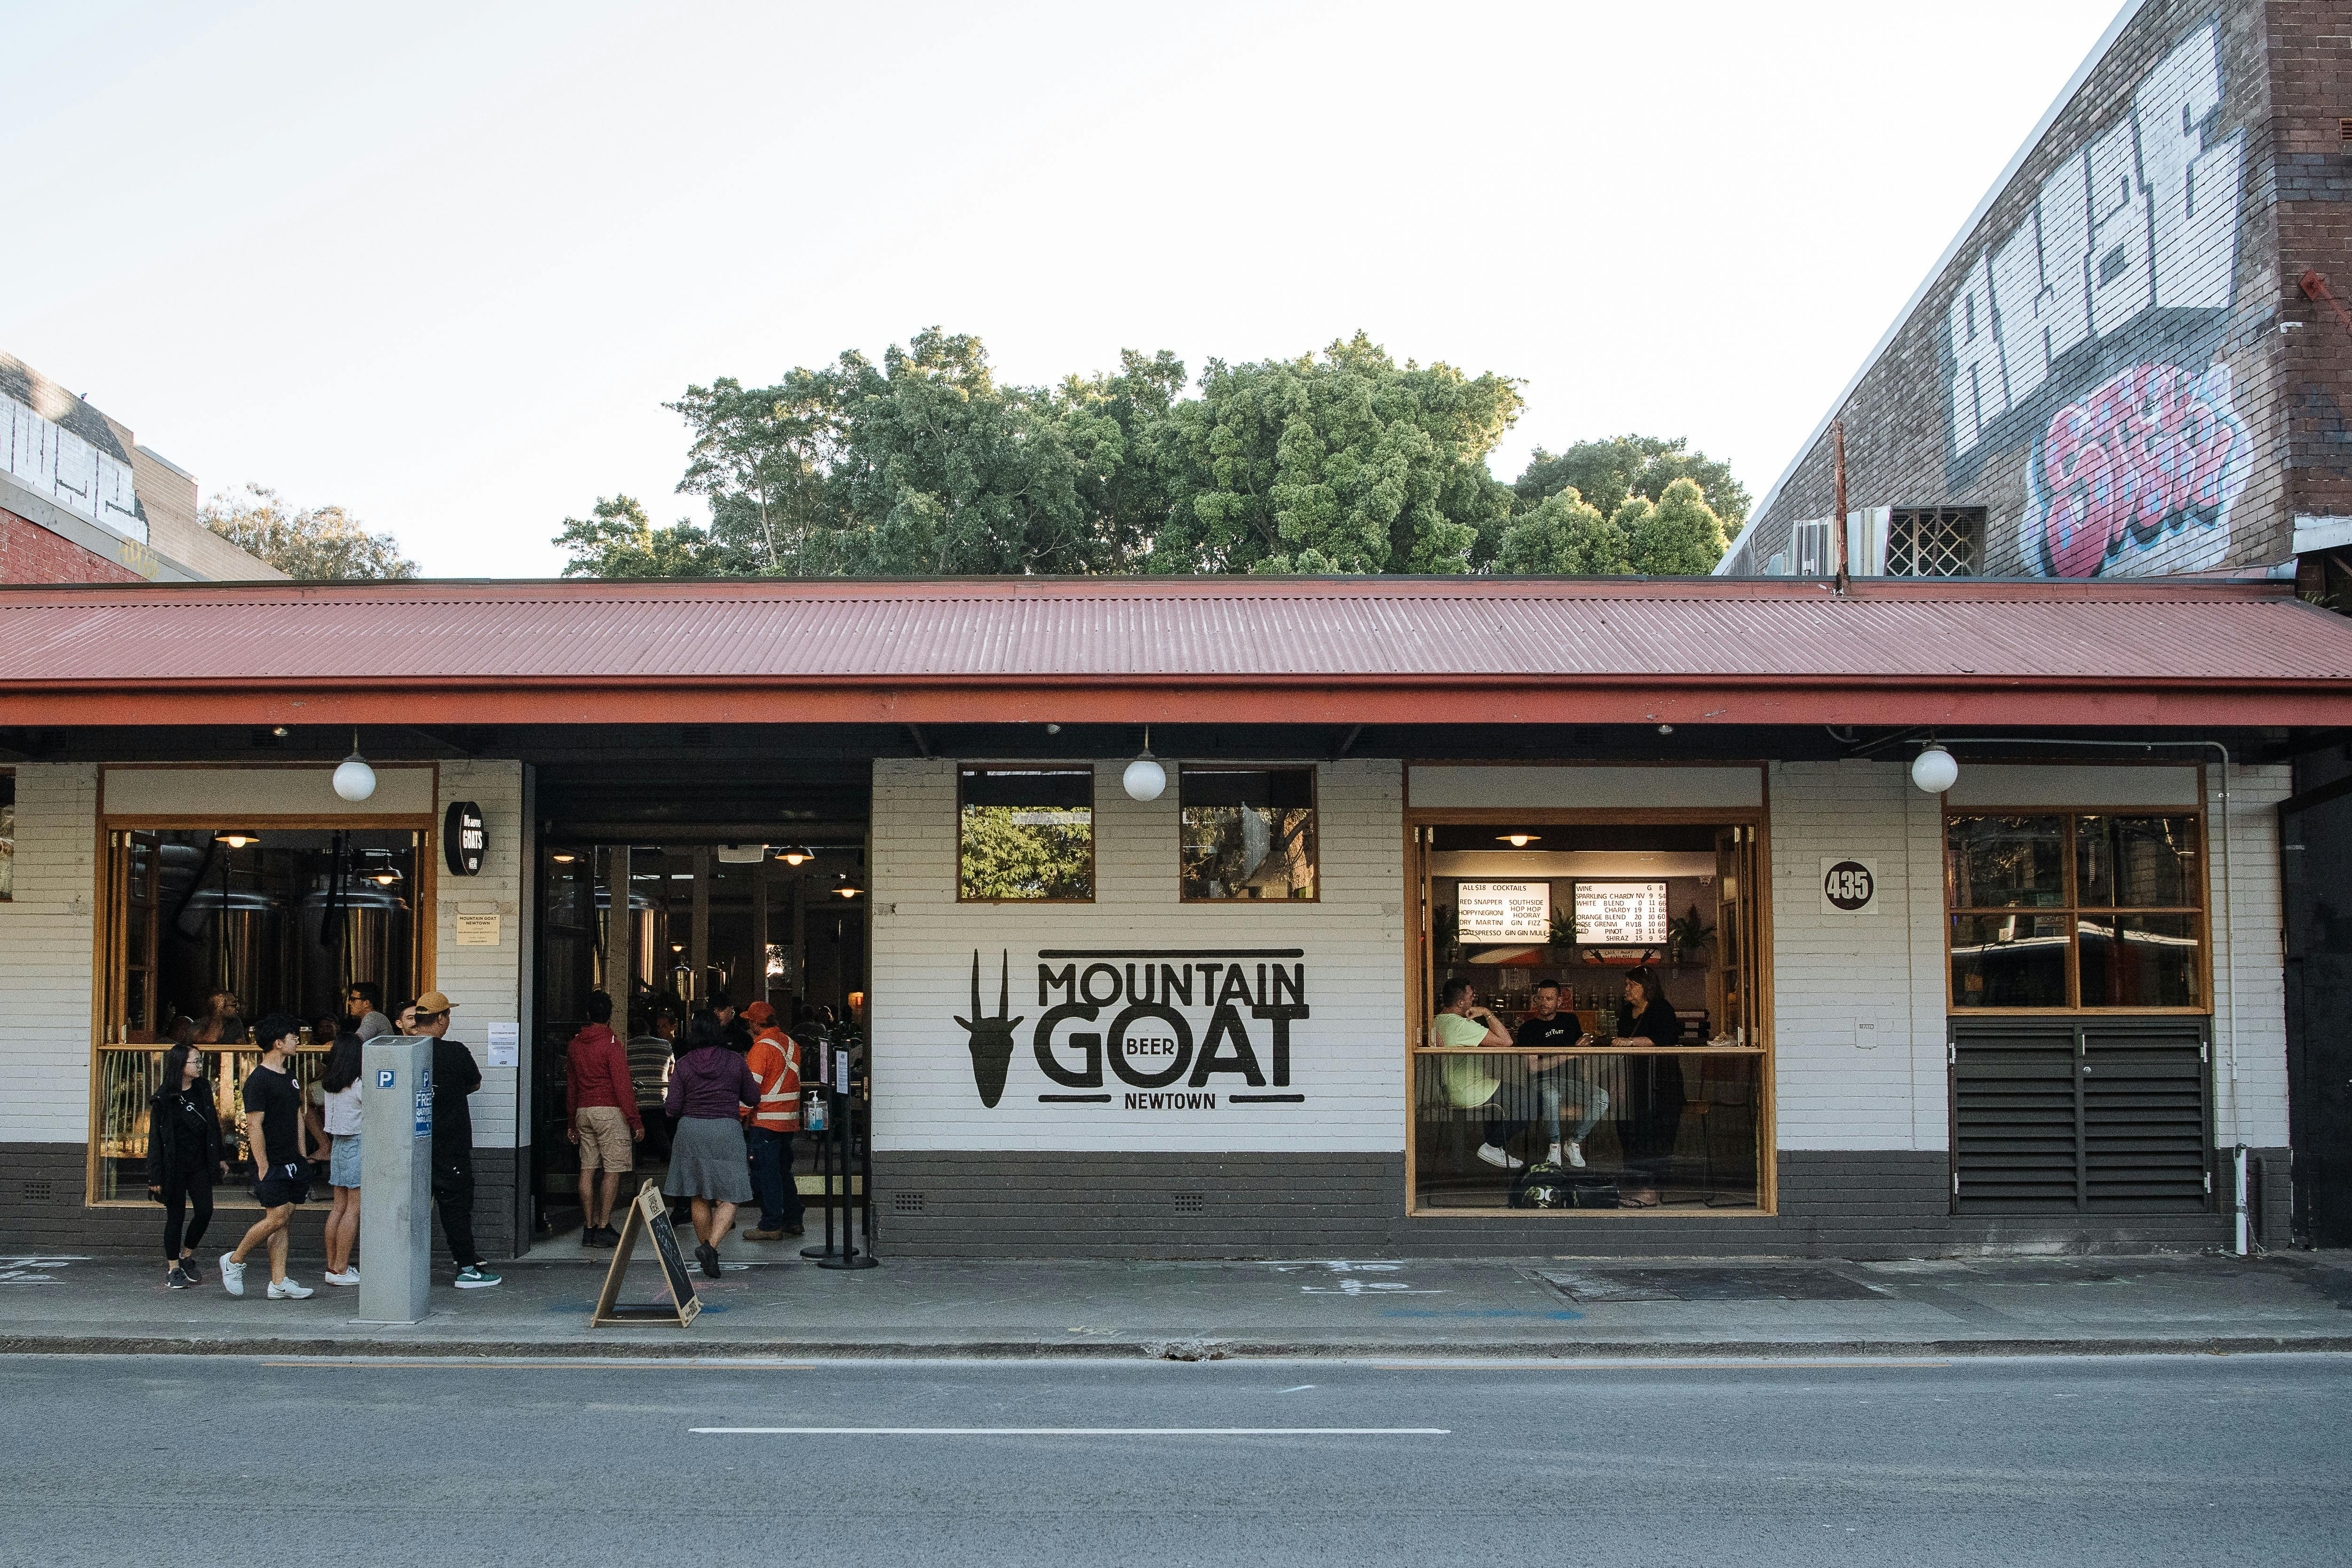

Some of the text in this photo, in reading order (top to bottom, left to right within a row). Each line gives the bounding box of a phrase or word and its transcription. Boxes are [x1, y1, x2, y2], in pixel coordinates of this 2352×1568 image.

[463, 830, 482, 849] GOATS
[1828, 871, 1868, 899] 435
[1038, 963, 1304, 1007] MOUNTAIN
[1033, 1003, 1310, 1088] GOAT
[1127, 1038, 1174, 1055] BEER
[380, 1072, 392, 1087] P
[424, 1072, 428, 1087] P
[416, 1093, 431, 1106] FREE
[1125, 1093, 1216, 1110] NEWTOWN
